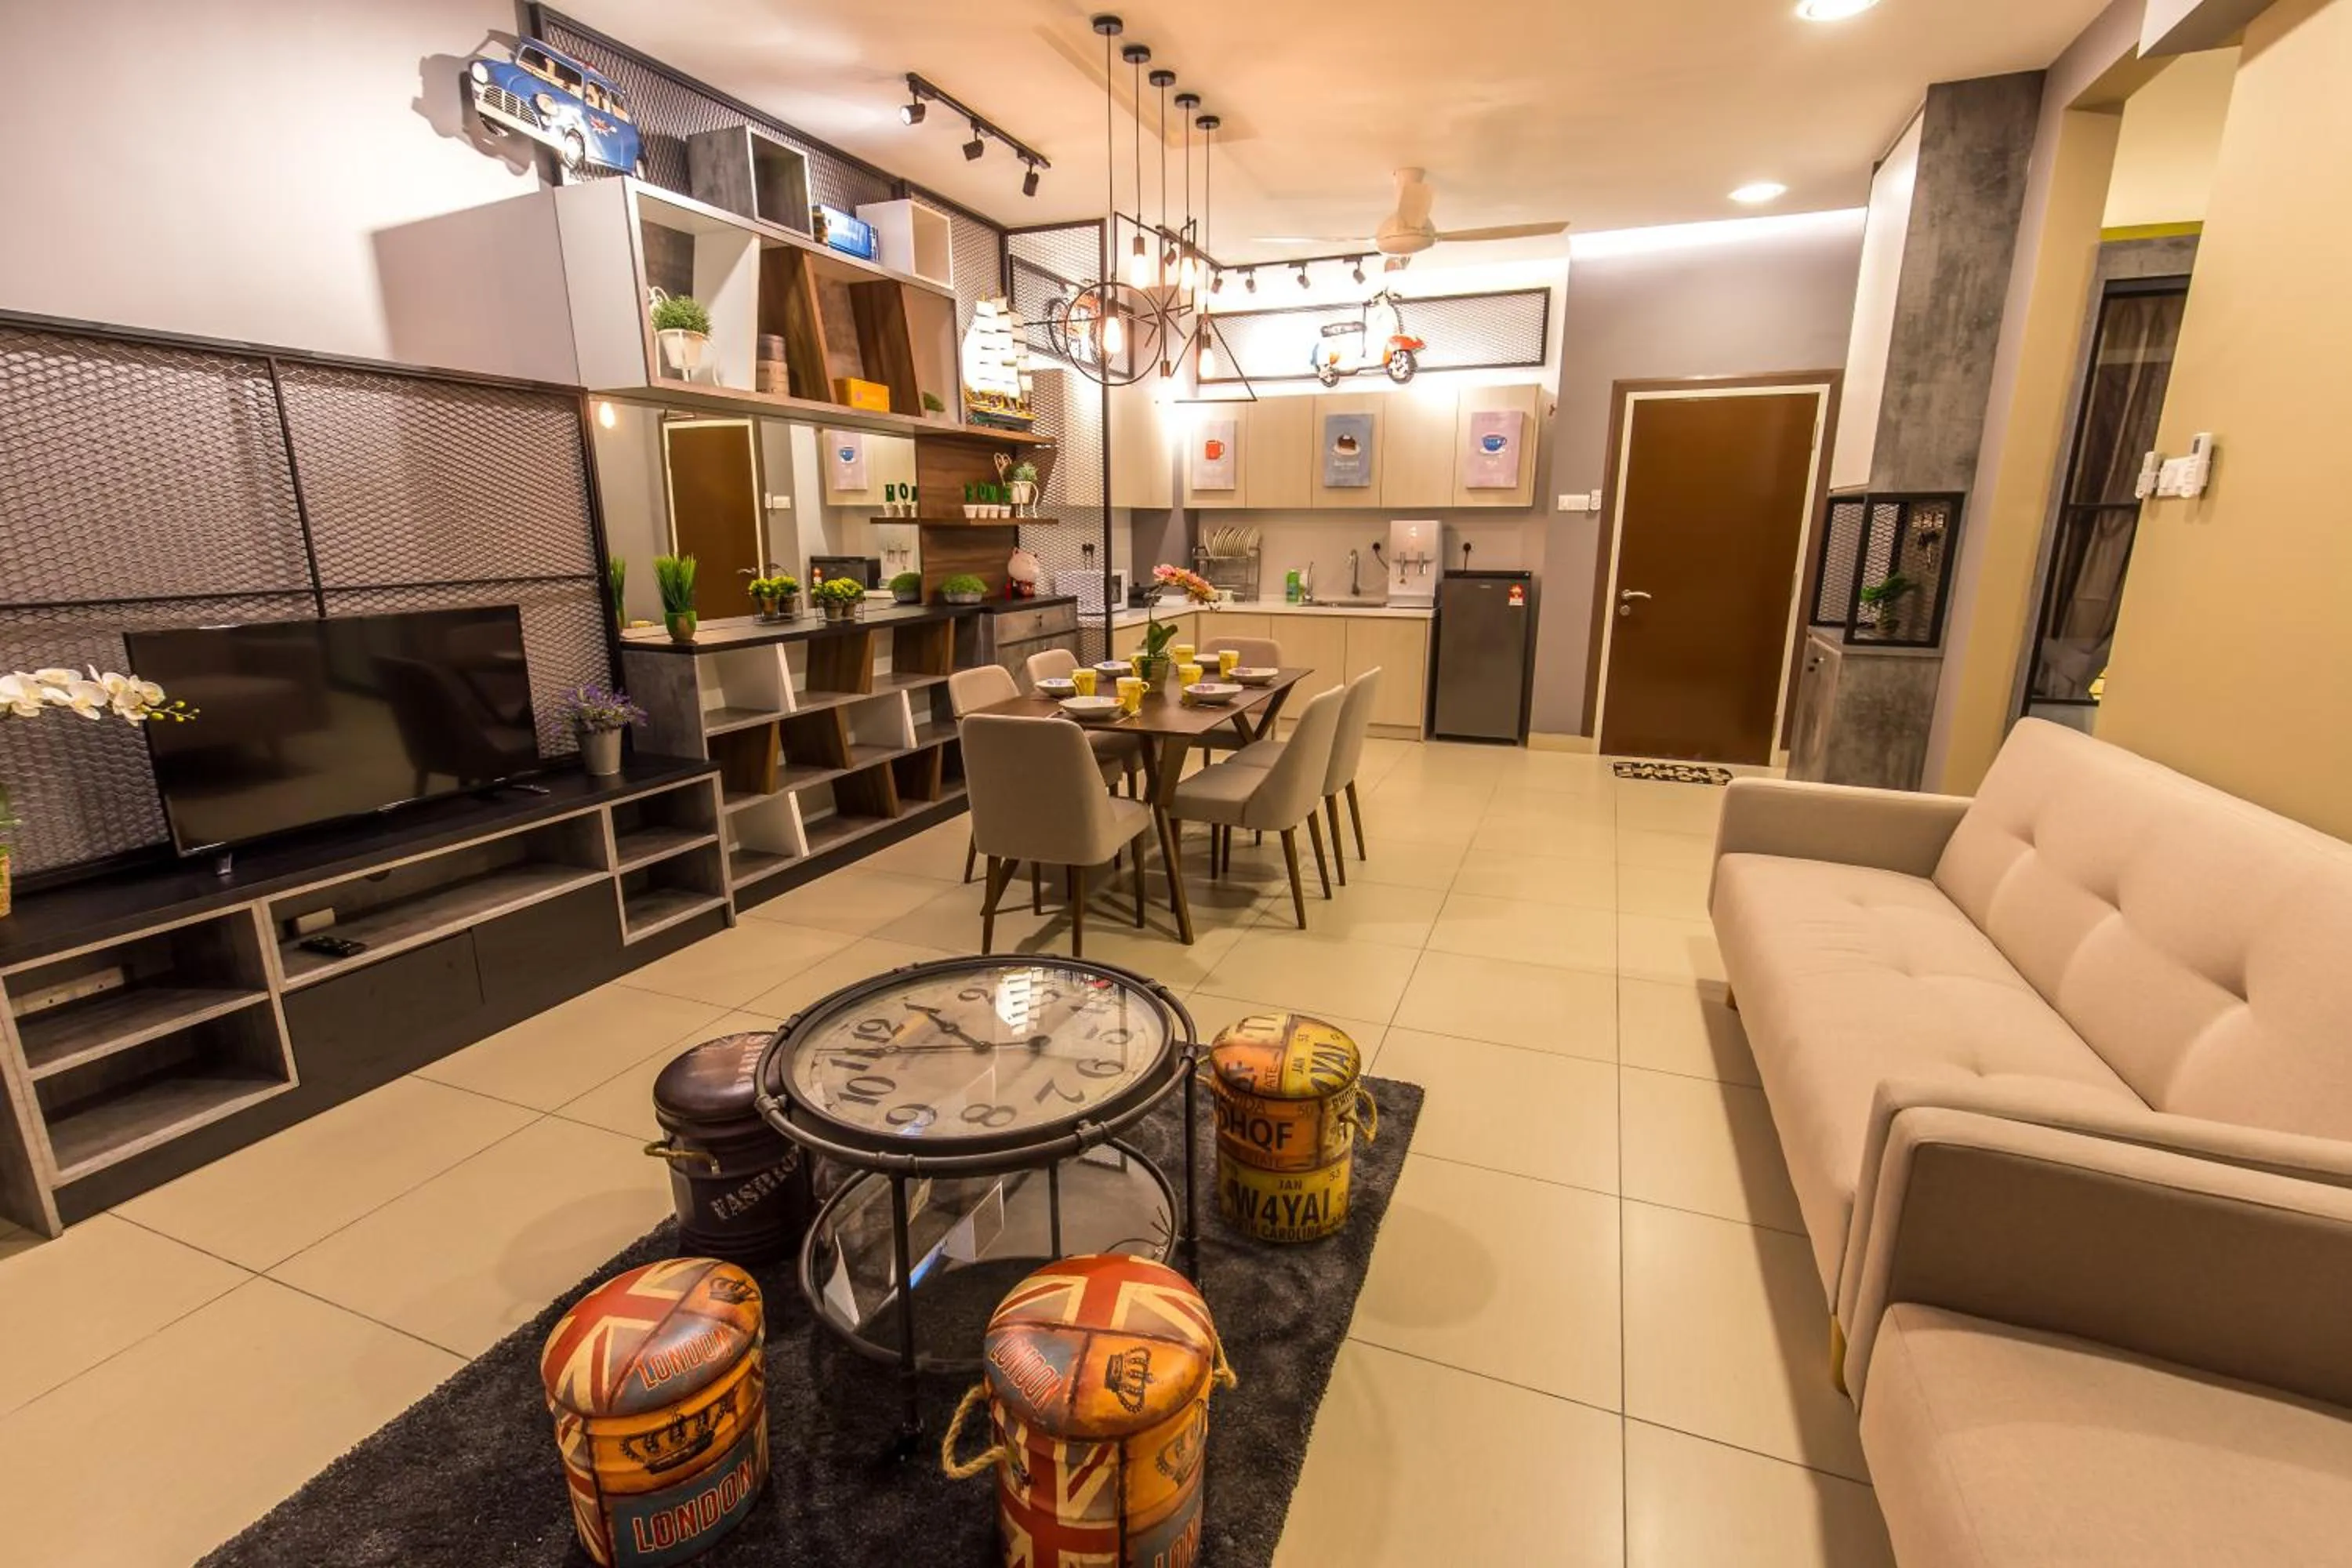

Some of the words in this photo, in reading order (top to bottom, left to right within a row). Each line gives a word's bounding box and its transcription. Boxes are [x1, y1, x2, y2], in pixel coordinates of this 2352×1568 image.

[852, 1018, 905, 1044] 12
[837, 1075, 897, 1105] 10
[1033, 1078, 1086, 1105] 7
[885, 1103, 938, 1127] 9
[960, 1102, 1018, 1128] 8
[1278, 1178, 1303, 1191] JAN
[636, 1325, 731, 1390] LONDON
[990, 1332, 1063, 1416] LONDON
[633, 1455, 753, 1553] LONDON
